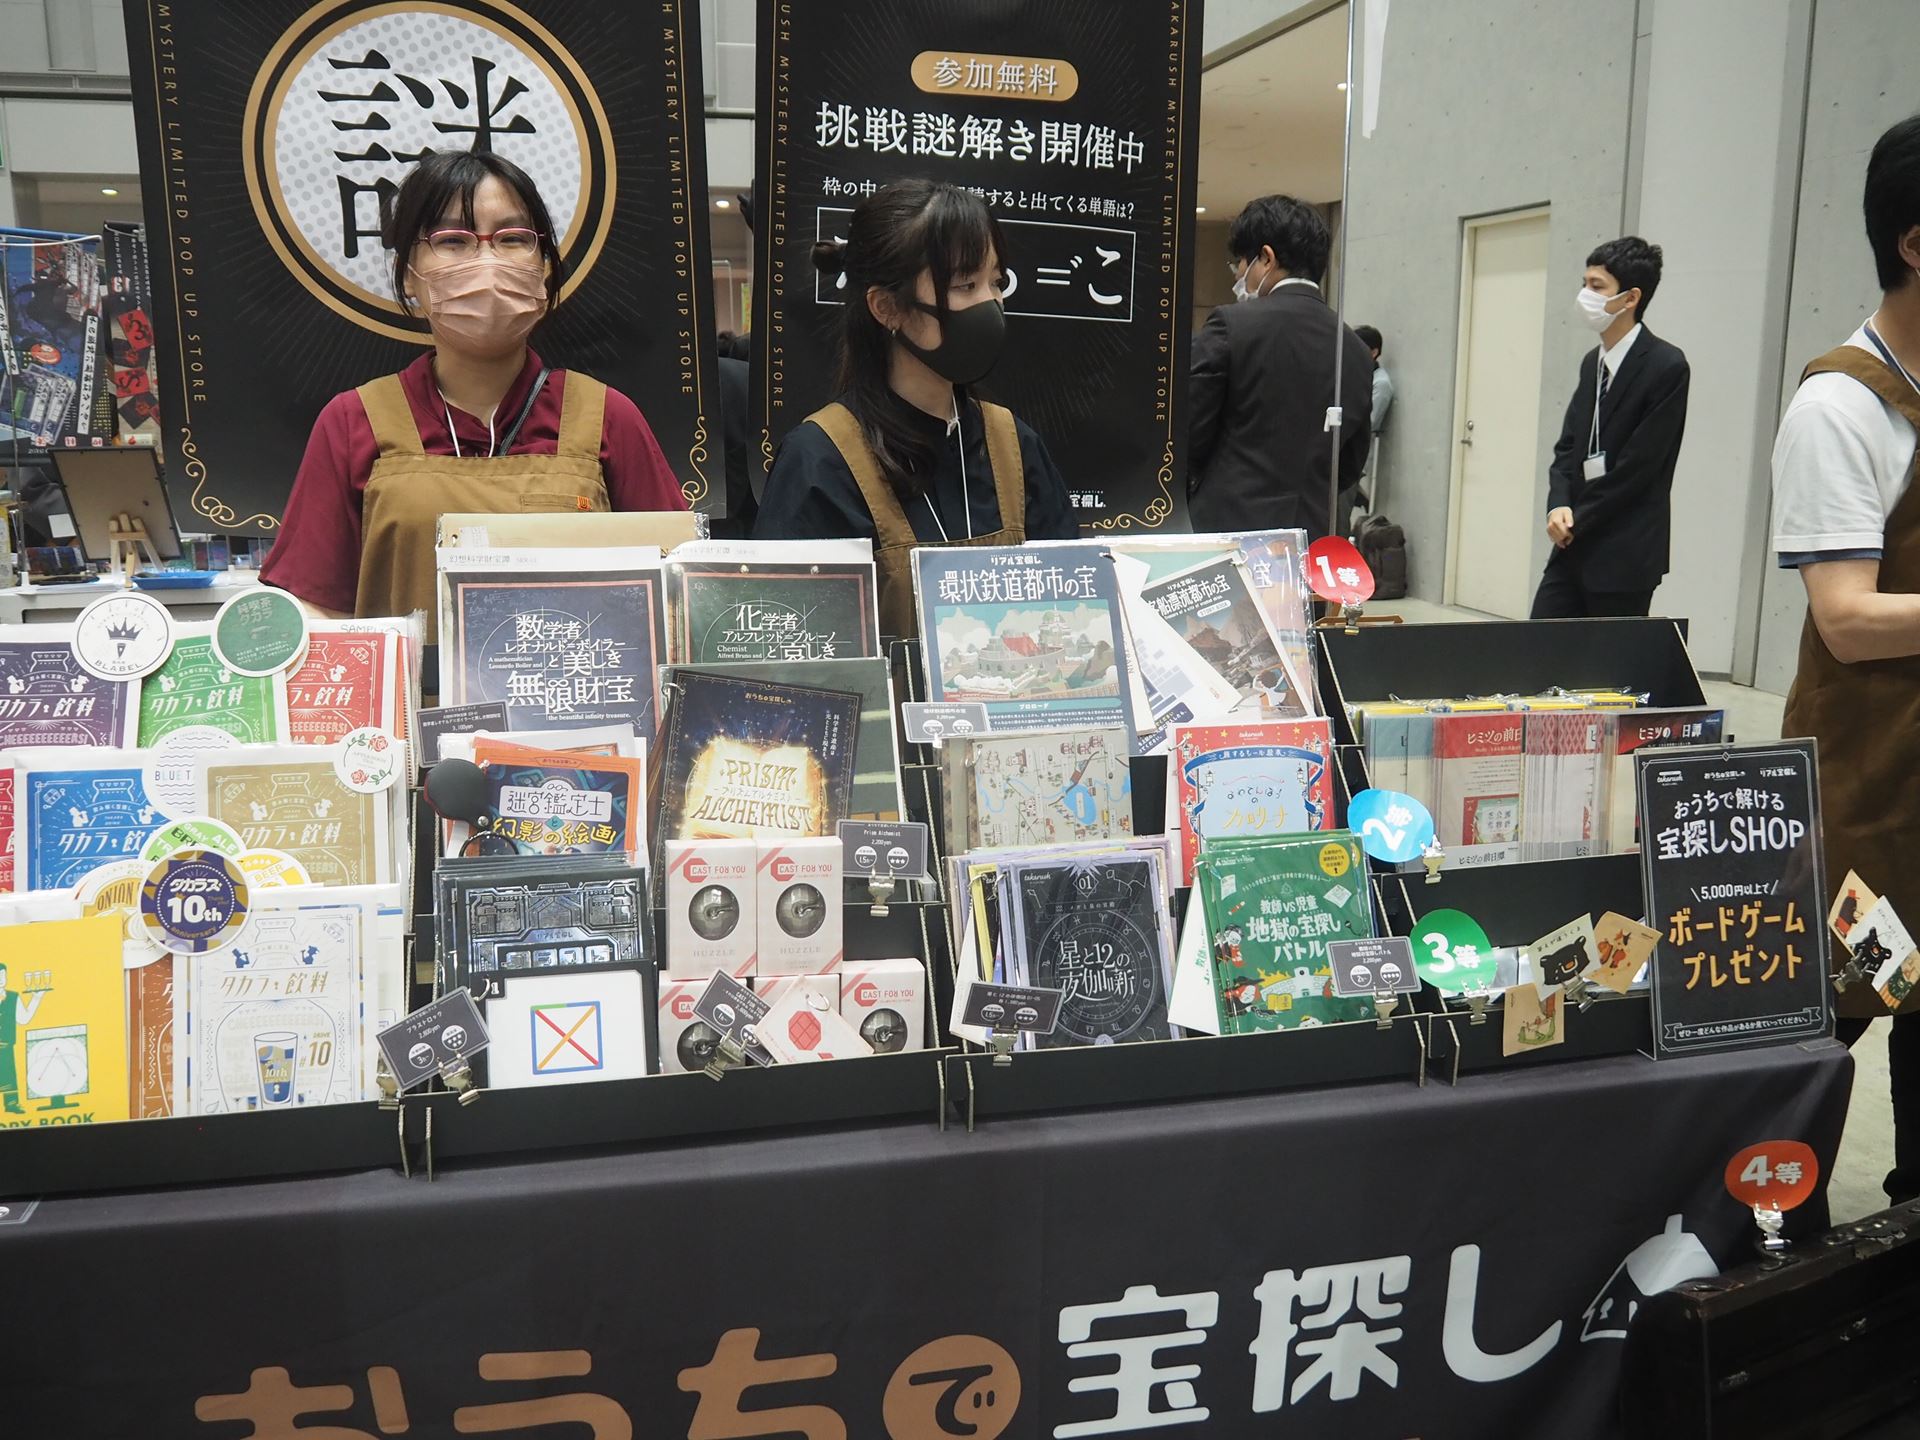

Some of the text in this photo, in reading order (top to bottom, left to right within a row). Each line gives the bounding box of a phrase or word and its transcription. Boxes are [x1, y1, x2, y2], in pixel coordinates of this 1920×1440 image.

[663, 28, 679, 120] MYSTERY
[932, 56, 1058, 95] 参加無料
[777, 55, 790, 146] MYSTERY
[815, 101, 1145, 174] 挑戦謎解き開催中
[1164, 99, 1176, 182] MYSTERY
[669, 136, 684, 225] LIMITED
[157, 4, 206, 402] MYSTERY LIMITED POP UP STORE
[775, 160, 786, 246] LIMITED
[1162, 195, 1173, 273] LIMITED
[674, 241, 686, 277] POP
[773, 261, 784, 296] POP
[677, 292, 689, 316] UP
[1160, 286, 1170, 320] POP
[773, 310, 783, 333] UP
[1158, 333, 1168, 354] UP
[679, 331, 693, 394] STORE
[772, 347, 783, 408] STORE
[1156, 365, 1167, 421] STORE
[938, 565, 1098, 604] 環状鉄道都市の宝
[1315, 555, 1360, 588] 1等
[515, 613, 582, 641] 数学者
[736, 604, 798, 631] 化学者
[95, 660, 143, 673] BLABEL
[549, 650, 622, 678] と美しき
[506, 670, 637, 715] 無限財宝
[559, 713, 584, 721] beautiful
[585, 713, 605, 721] infinity
[606, 712, 631, 720] treasure.
[724, 758, 798, 792] PRISM
[506, 789, 606, 817] 迷宮鑑定士
[690, 794, 814, 832] ALCHEMIST
[1673, 787, 1785, 820] おうちで解ける
[492, 817, 618, 846] 幻影の絵画
[1657, 815, 1805, 860] 宝探しSHOP
[692, 866, 712, 875] CAST
[732, 865, 746, 874] YOU
[779, 864, 799, 873] CAST
[818, 863, 833, 872] YOU
[1078, 876, 1093, 890] 01
[97, 883, 134, 912] ONION
[167, 894, 223, 924] 10th
[1245, 912, 1342, 944] 地獄の宝探し
[1668, 900, 1806, 947] ボードゲーム
[1059, 940, 1131, 971] 星と12の
[1272, 939, 1326, 964] バトル
[1425, 931, 1481, 974] 3等
[1683, 943, 1802, 991] プレゼント
[862, 990, 882, 1000] CAST
[900, 988, 914, 998] YOU
[1739, 1154, 1804, 1188] 4等
